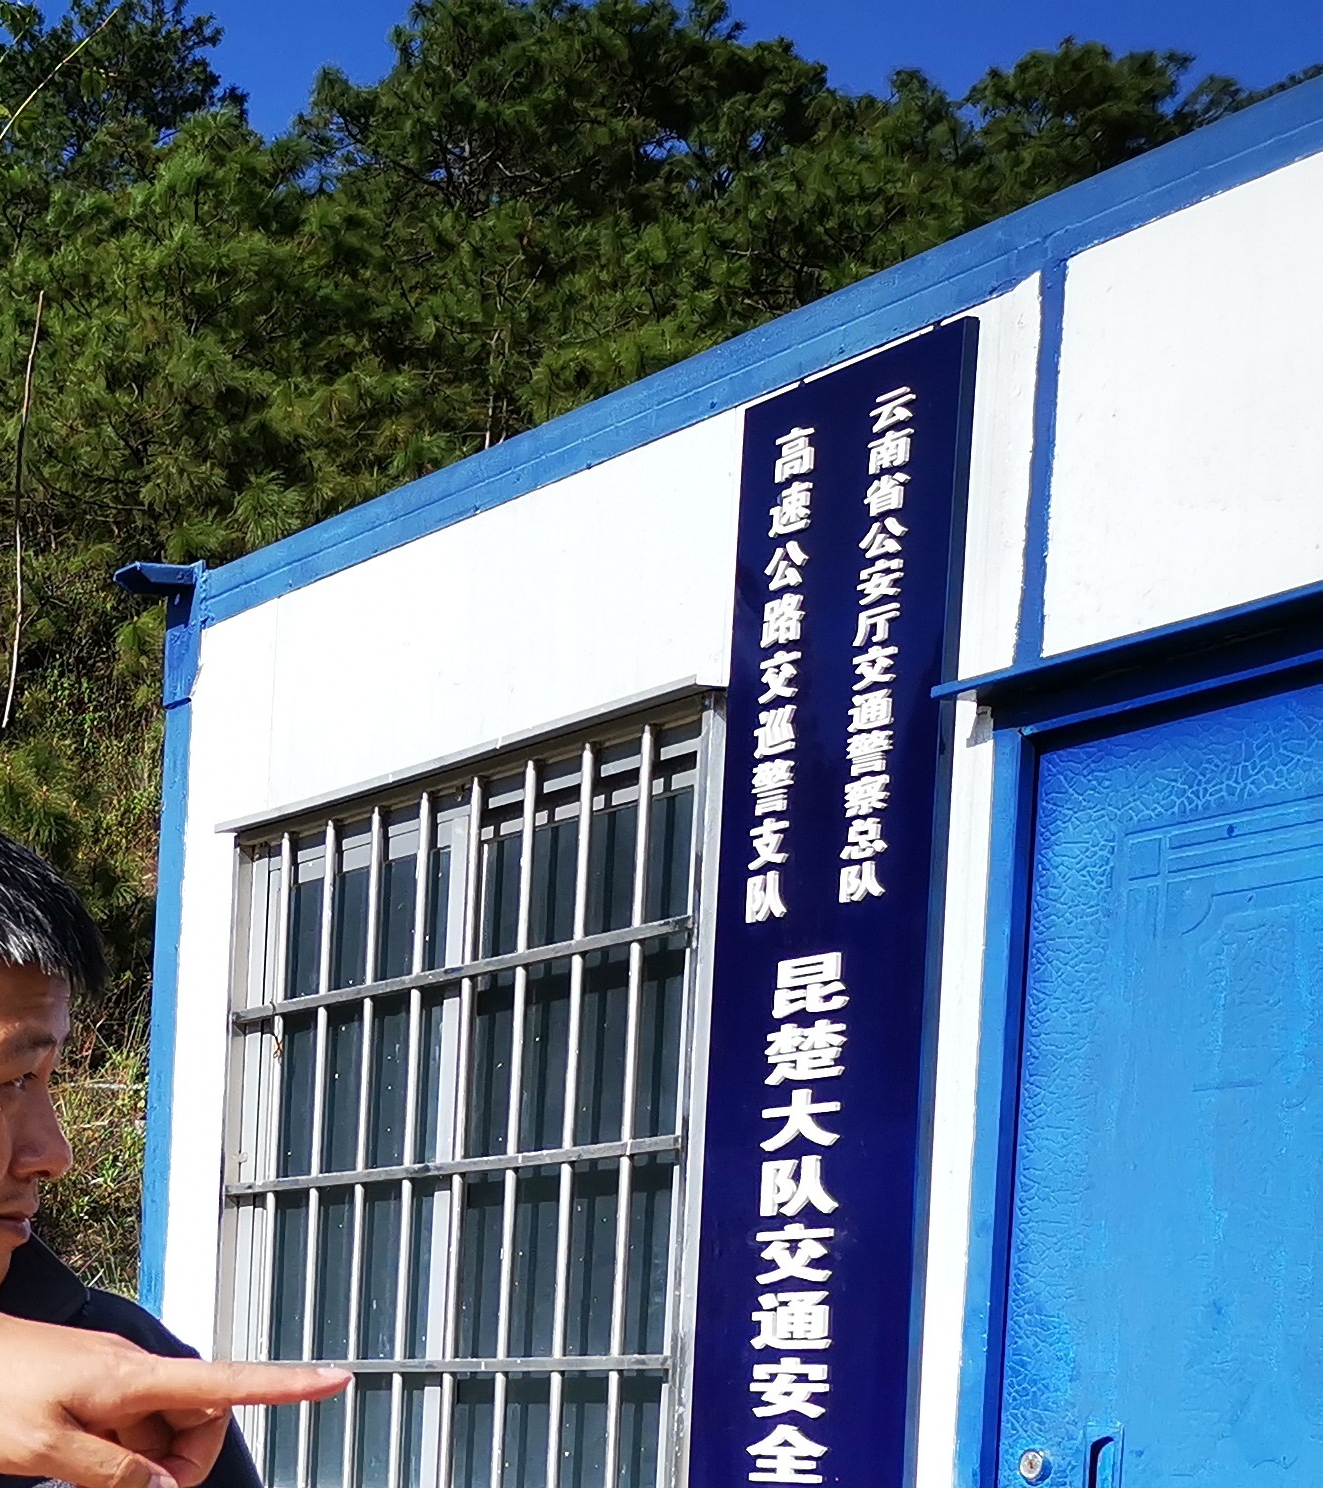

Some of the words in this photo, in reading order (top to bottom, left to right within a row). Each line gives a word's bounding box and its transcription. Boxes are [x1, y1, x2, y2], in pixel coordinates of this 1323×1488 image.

[745, 427, 815, 923] 高速公路交巡警支队
[839, 386, 917, 903] 云南省公安厅交通警察总队
